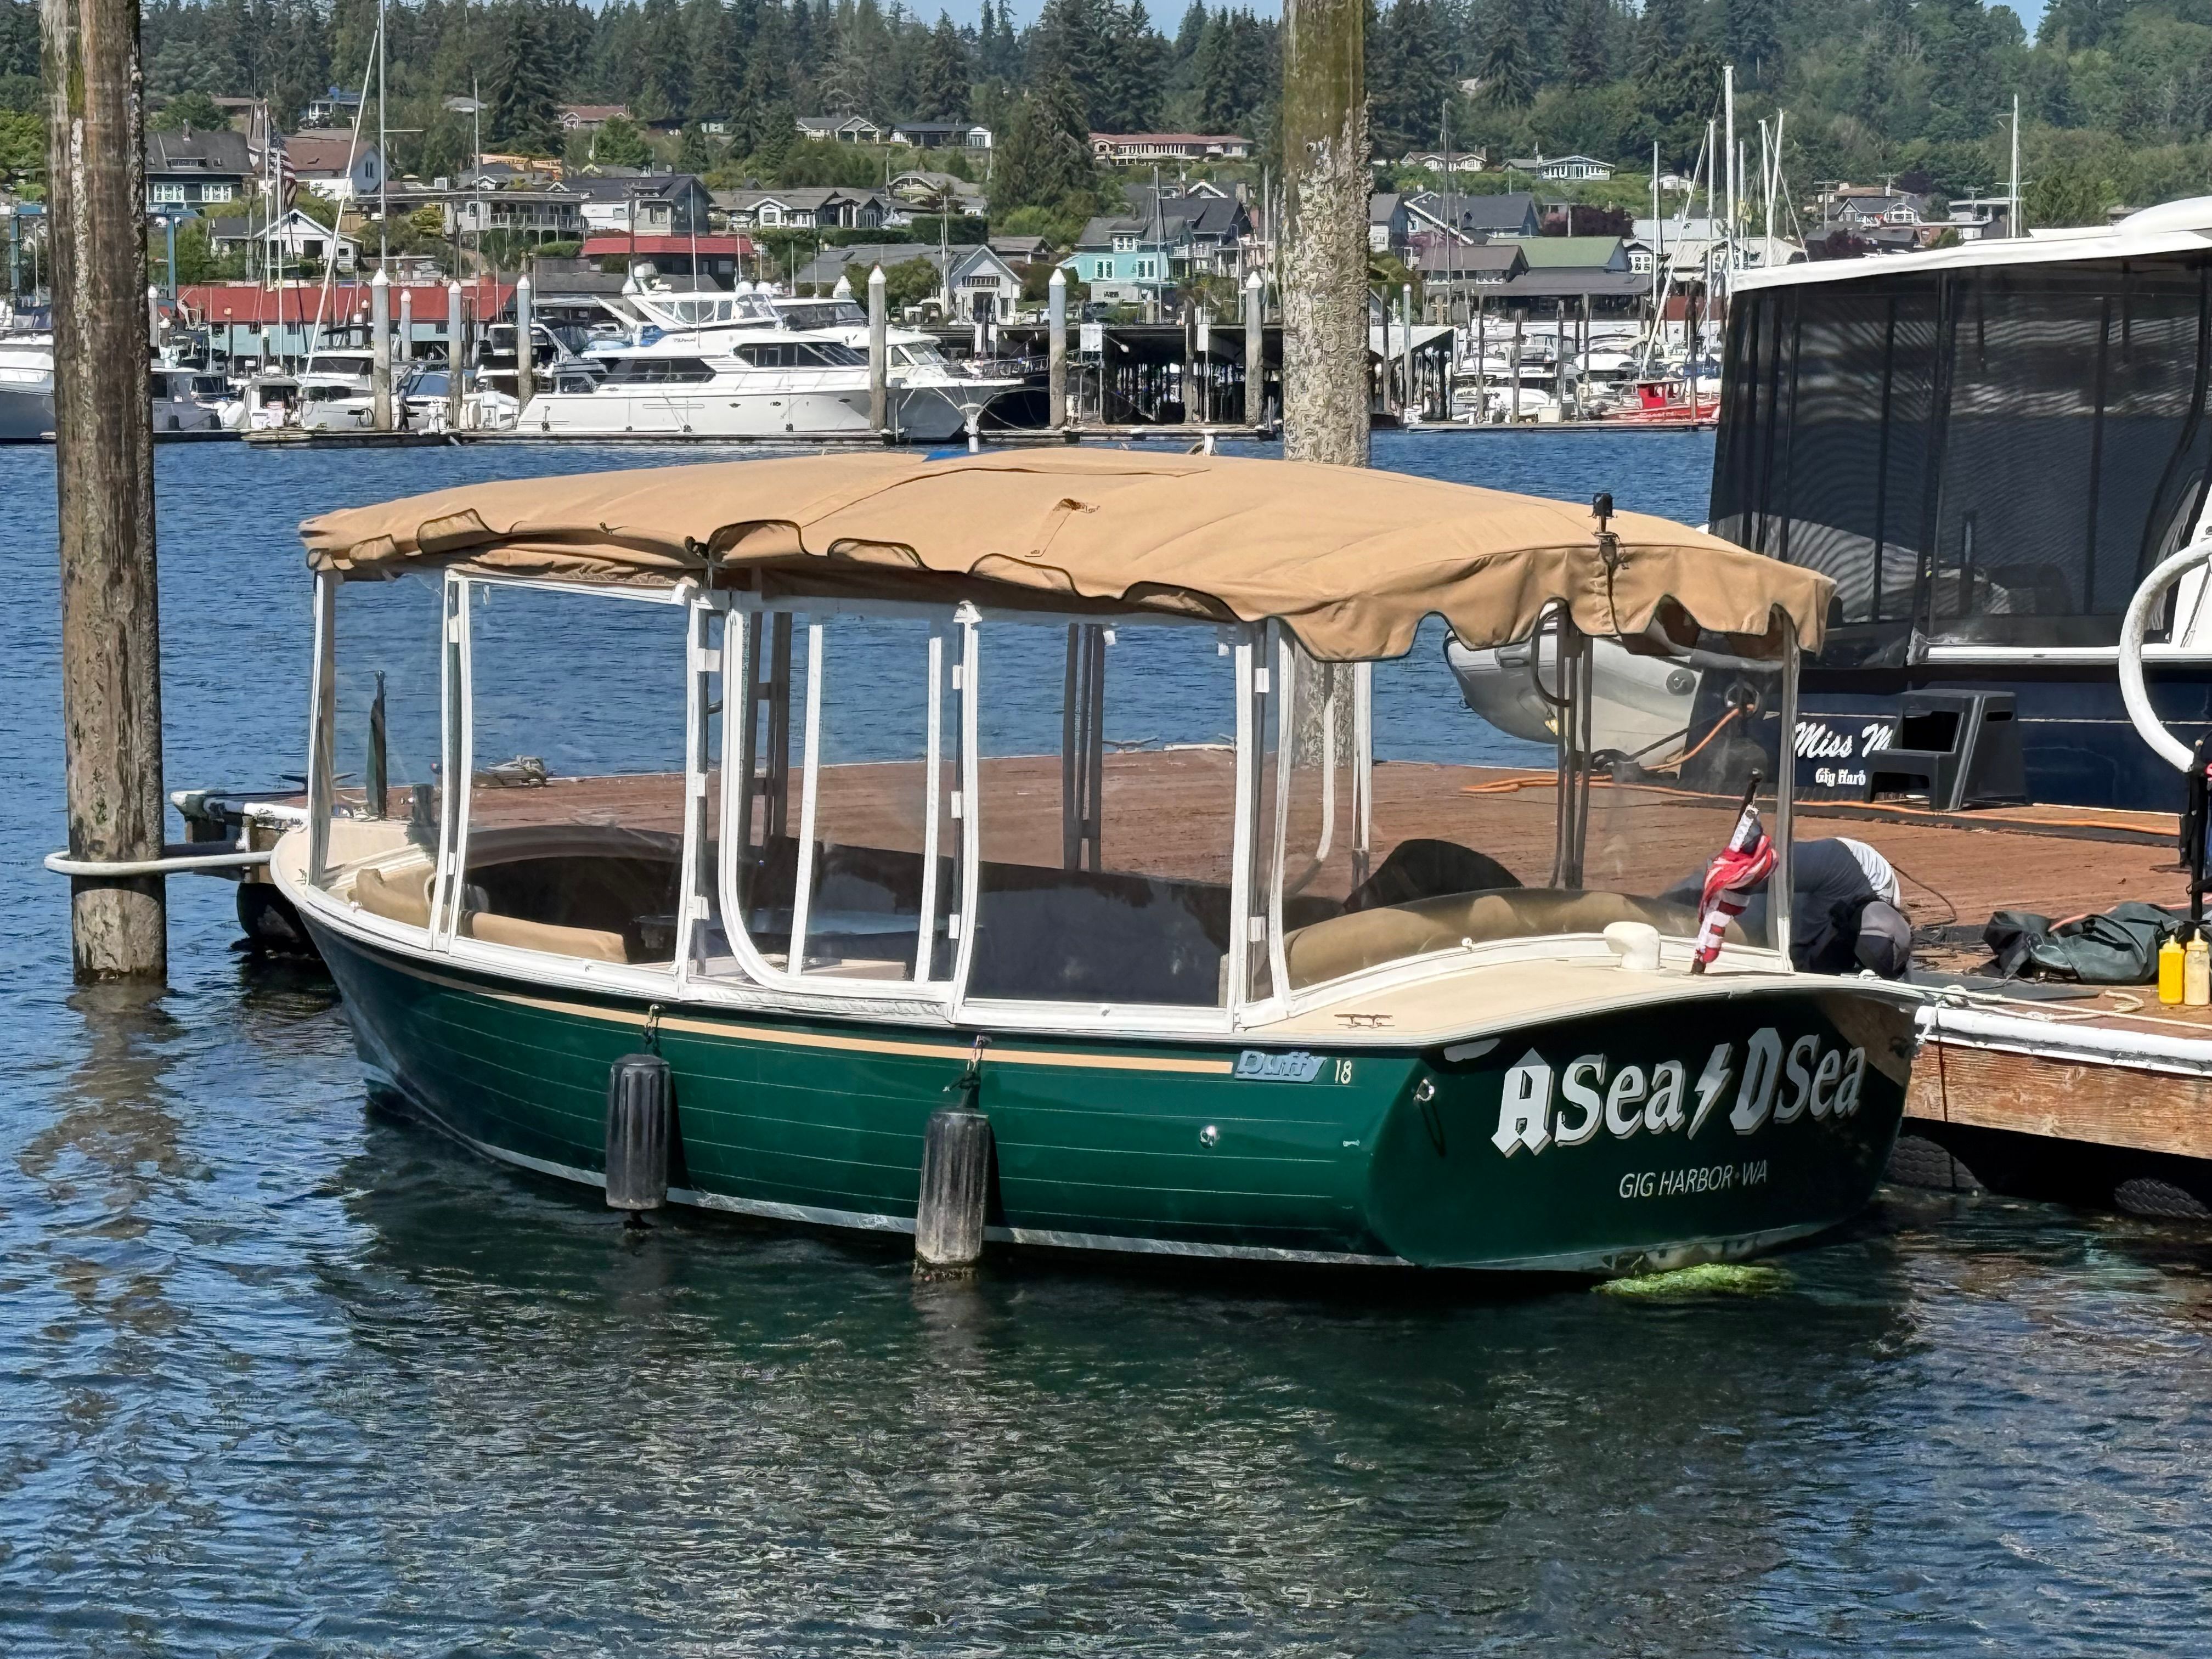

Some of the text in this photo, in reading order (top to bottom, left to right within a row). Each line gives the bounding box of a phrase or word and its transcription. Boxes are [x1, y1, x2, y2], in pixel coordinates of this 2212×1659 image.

[1794, 721, 1852, 758] Miss
[1815, 768, 1836, 787] Gig
[1236, 1050, 1352, 1084] Duffy 18
[1619, 1159, 1768, 1198] GIG HARBOR WA
